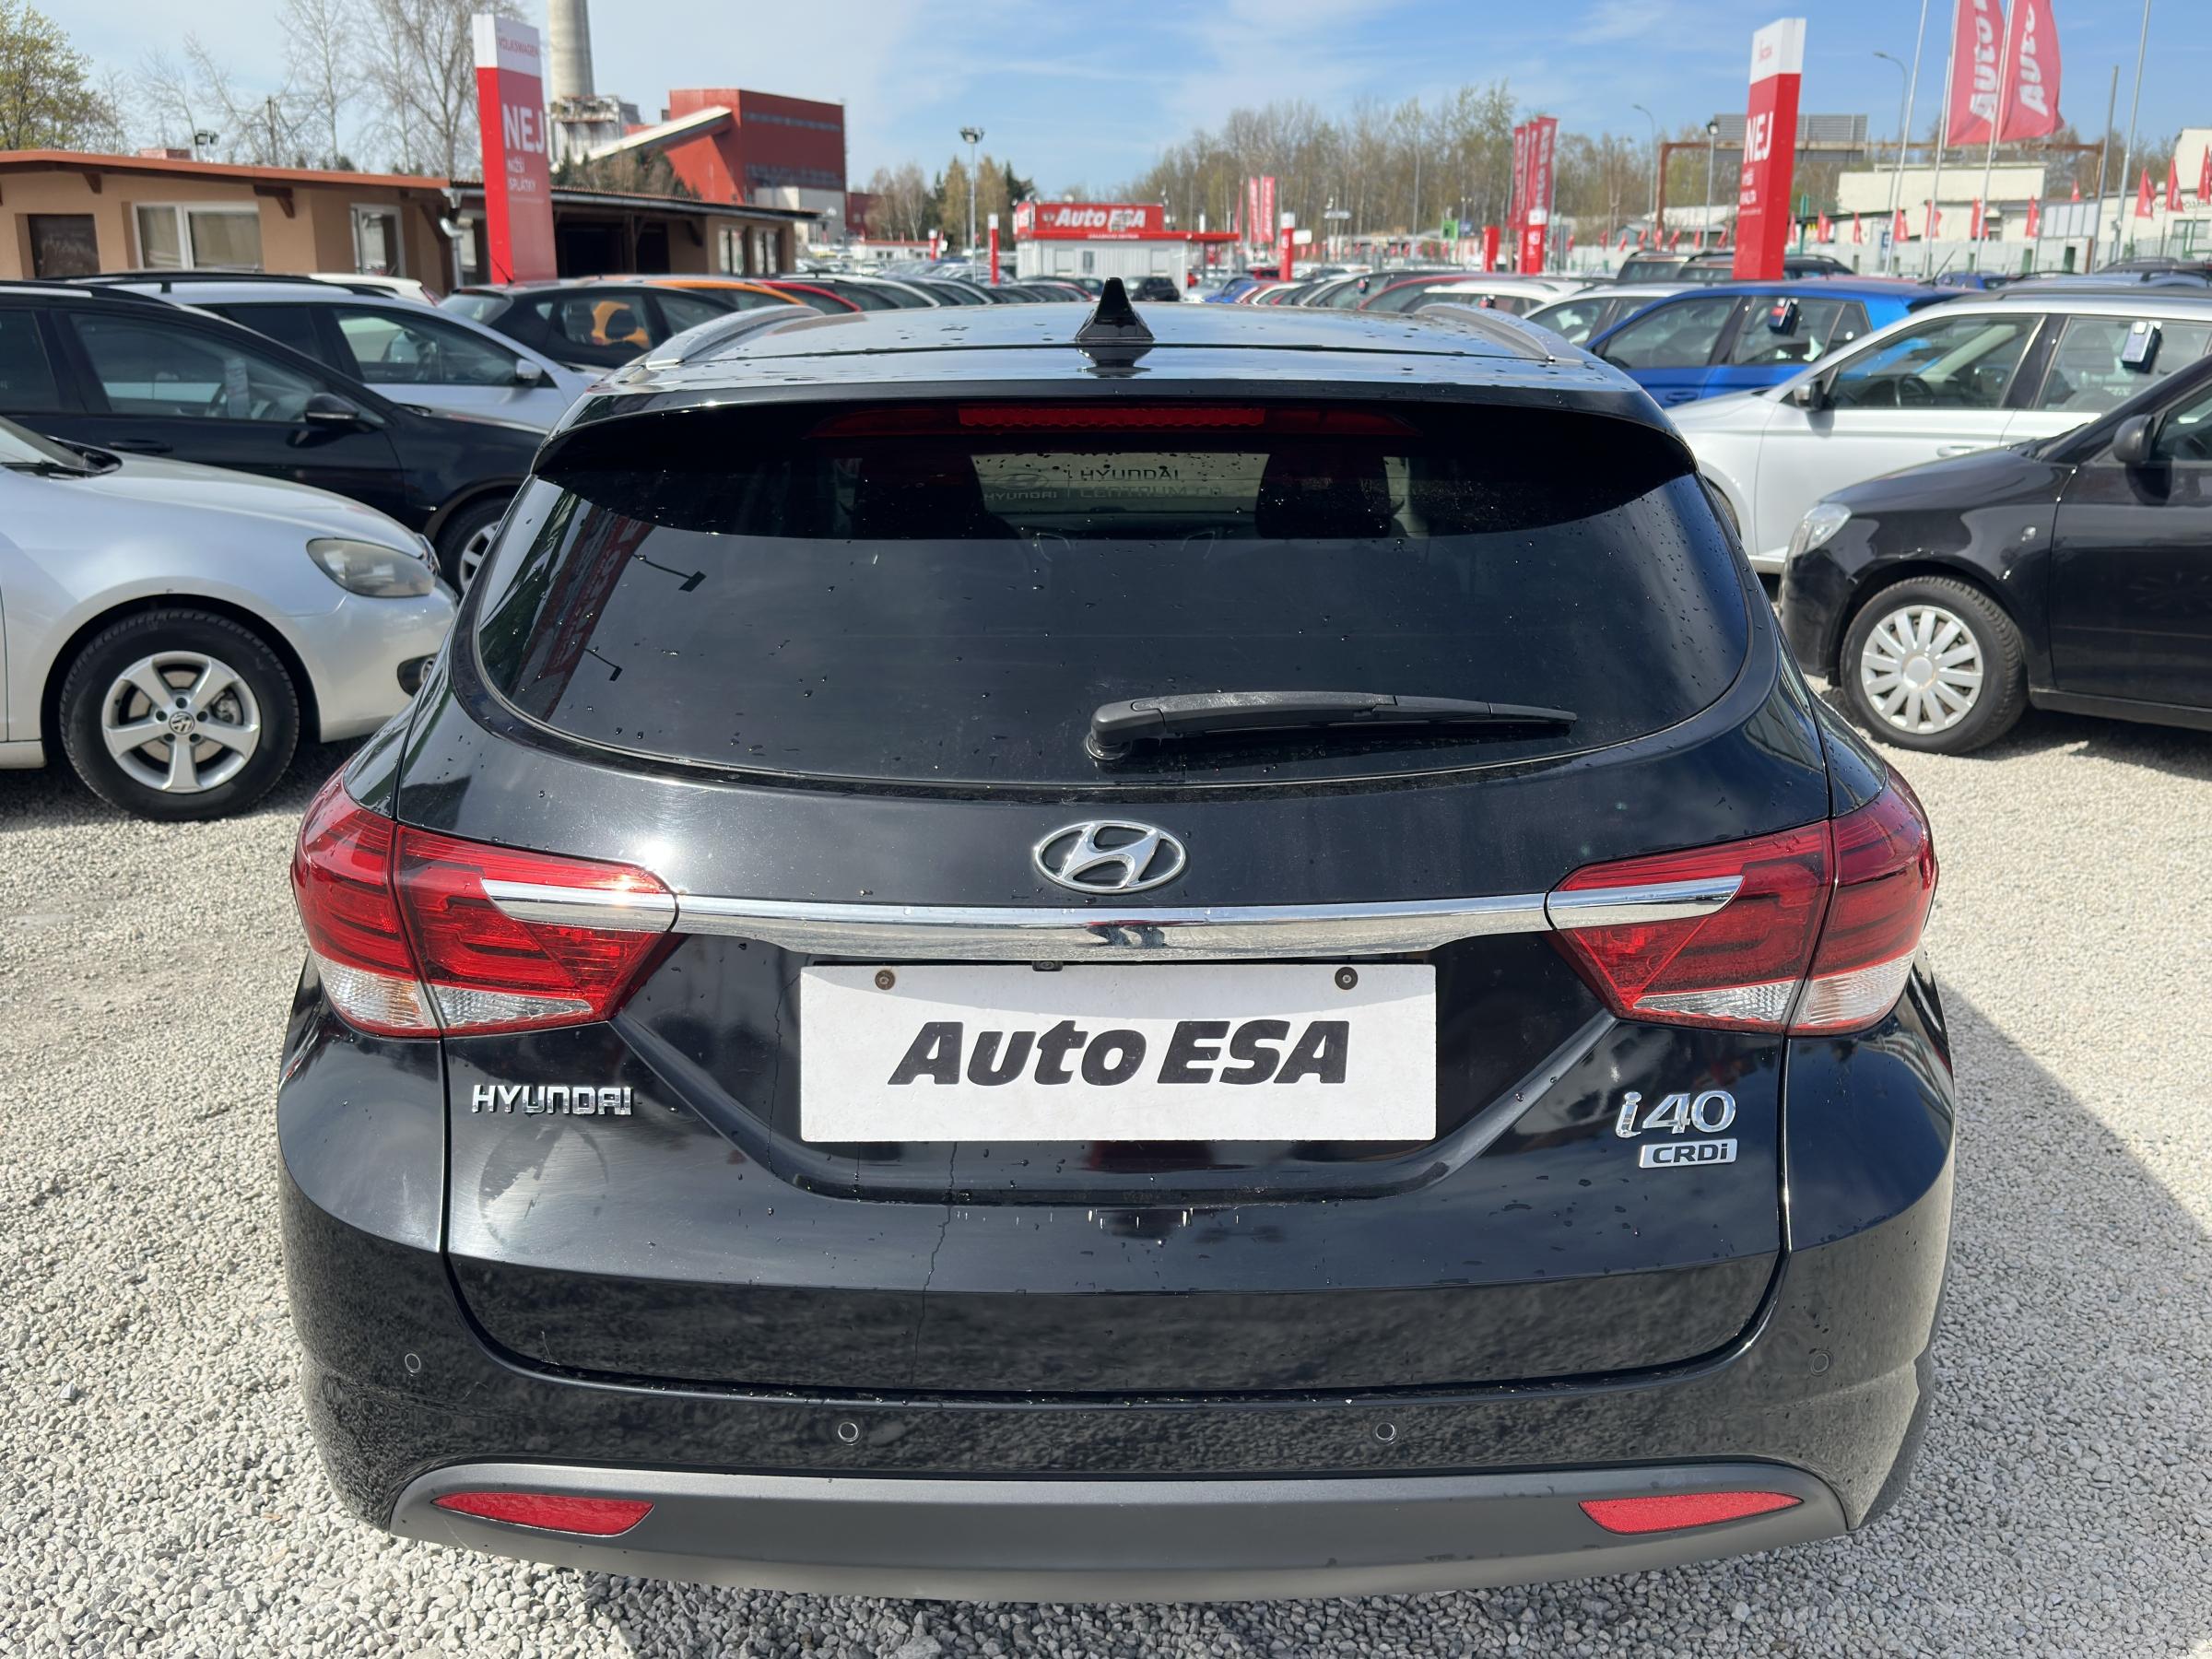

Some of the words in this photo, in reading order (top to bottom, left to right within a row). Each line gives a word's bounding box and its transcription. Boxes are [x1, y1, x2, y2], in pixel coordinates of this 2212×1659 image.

[1969, 16, 1998, 124] Auto
[2018, 3, 2049, 116] Auto
[501, 103, 545, 154] NEJ
[1744, 112, 1774, 164] NEJ
[1054, 207, 1106, 228] Auto
[1080, 468, 1180, 480] HYUNDAI
[887, 1020, 1147, 1086] Auto
[1157, 1020, 1350, 1085] ESA
[472, 1084, 632, 1115] HYUNDAI
[1616, 1090, 1736, 1138] i40
[1653, 1143, 1728, 1164] CRDi
